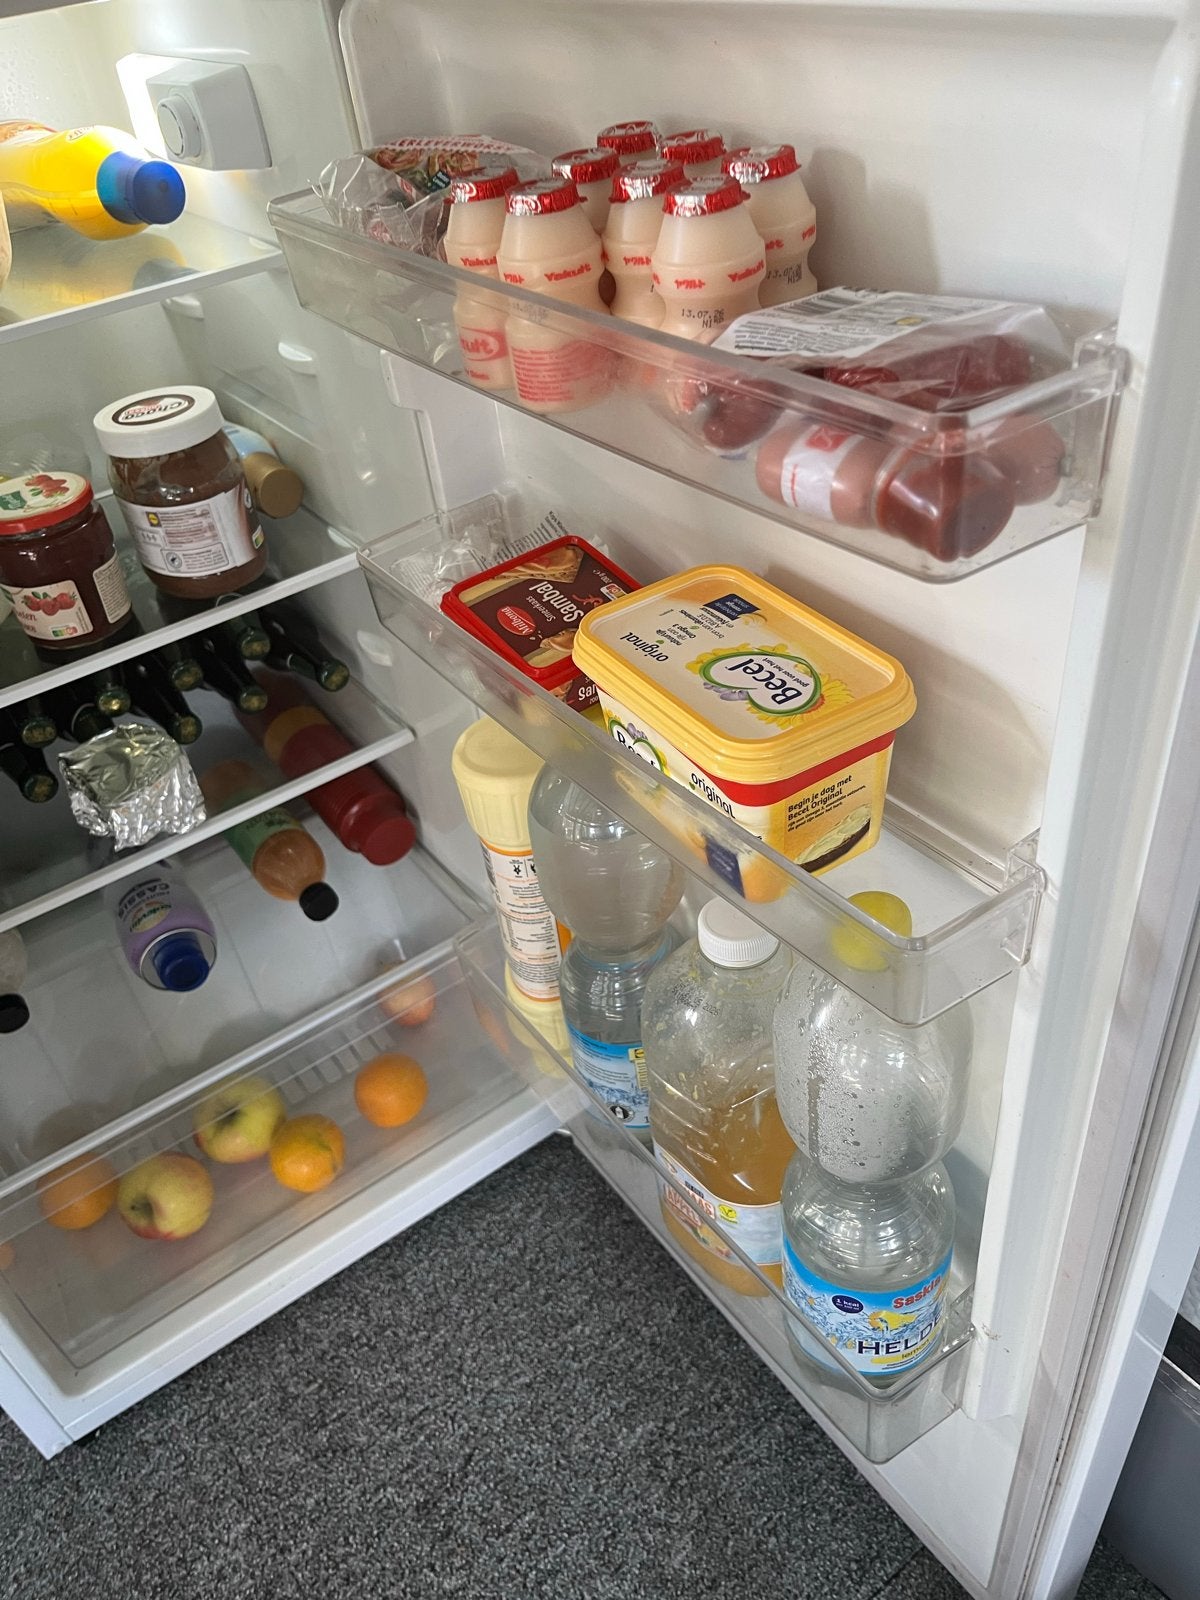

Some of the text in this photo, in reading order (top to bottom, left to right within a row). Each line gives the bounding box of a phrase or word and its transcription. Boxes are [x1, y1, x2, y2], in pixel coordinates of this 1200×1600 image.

[544, 263, 592, 282] Yakult
[124, 401, 181, 421] Choco
[526, 595, 556, 622] Smeerkaas
[528, 581, 585, 622] Sambal
[501, 605, 532, 636] Milbona
[620, 632, 670, 663] original
[760, 657, 776, 666] hart
[727, 658, 802, 705] Becel
[781, 670, 796, 678] voor
[791, 677, 810, 687] goed
[691, 772, 736, 819] original
[788, 775, 852, 813] Begin je dag met
[788, 788, 843, 821] Becel Original
[119, 883, 169, 918] CASSIS
[843, 1299, 860, 1307] kcal
[893, 1275, 941, 1309] Saskia
[858, 1311, 941, 1355] HELDE
[901, 1338, 930, 1360] lemon
